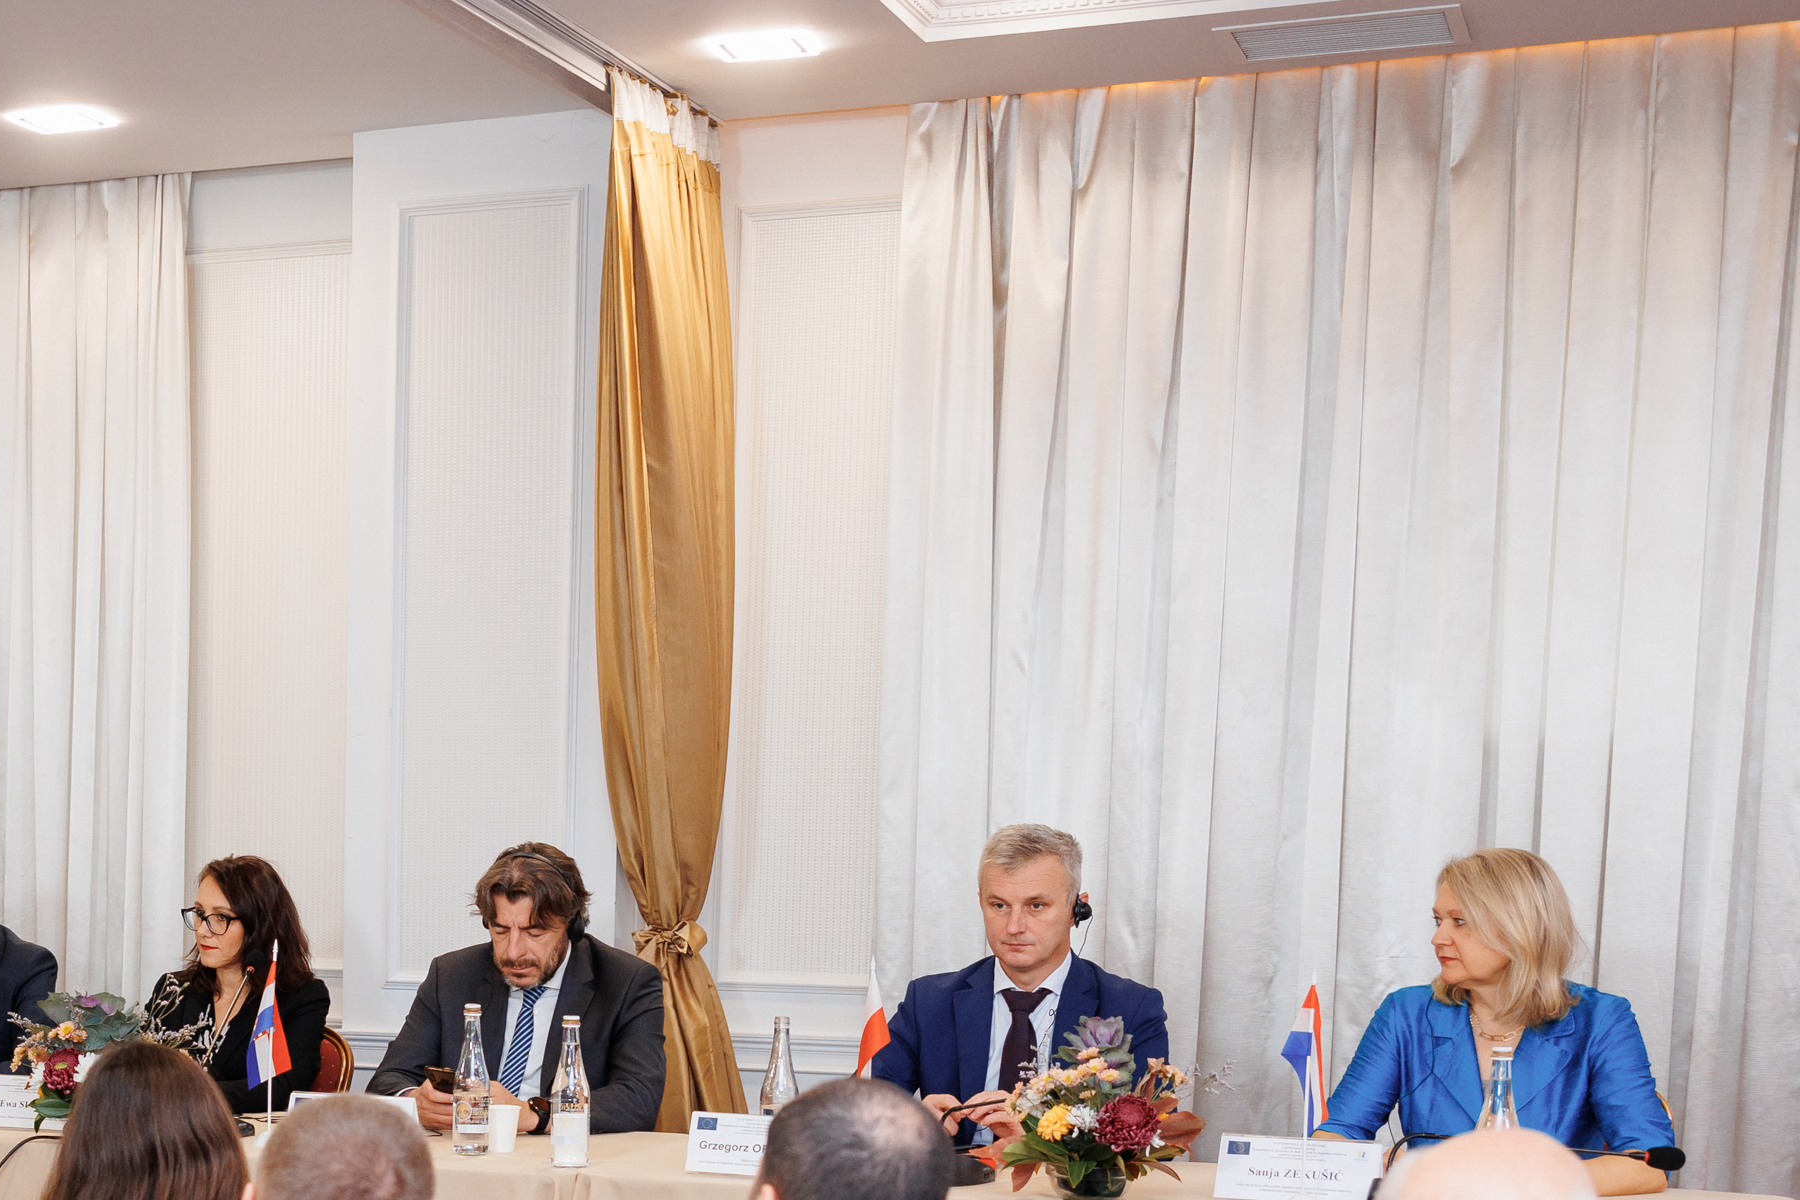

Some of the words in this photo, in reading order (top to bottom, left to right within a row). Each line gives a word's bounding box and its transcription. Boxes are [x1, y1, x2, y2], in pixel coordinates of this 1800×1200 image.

[0, 1099, 17, 1108] Ewa
[699, 1140, 749, 1153] Grzegorz
[1247, 1166, 1280, 1179] Sanja
